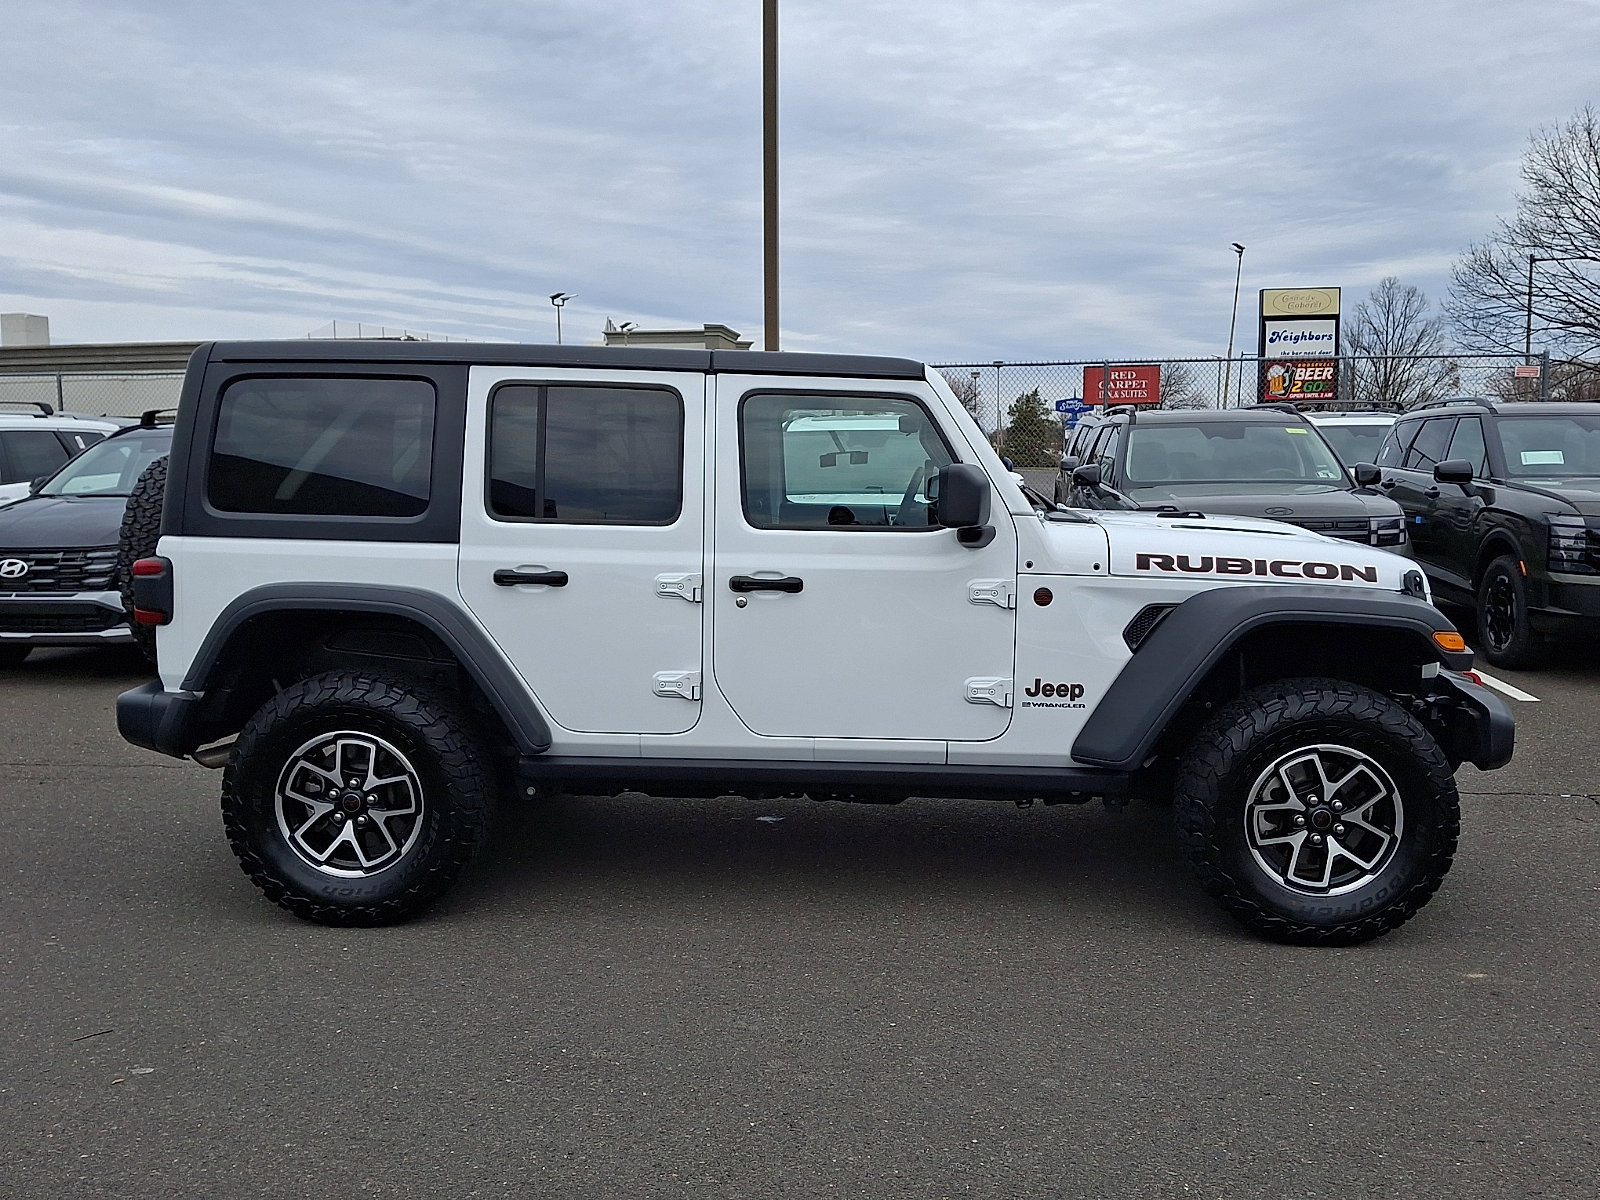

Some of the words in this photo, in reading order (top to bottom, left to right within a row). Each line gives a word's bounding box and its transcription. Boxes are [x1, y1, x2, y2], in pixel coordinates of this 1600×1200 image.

[1269, 330, 1333, 344] Neighbors
[1111, 371, 1137, 380] RED
[1295, 367, 1334, 380] BEER
[1098, 380, 1148, 389] CARPET
[1291, 381, 1302, 392] 2
[1303, 381, 1323, 392] GO
[1120, 390, 1148, 399] SUITES
[1135, 552, 1378, 583] RUBICON
[1025, 678, 1084, 701] Jeep
